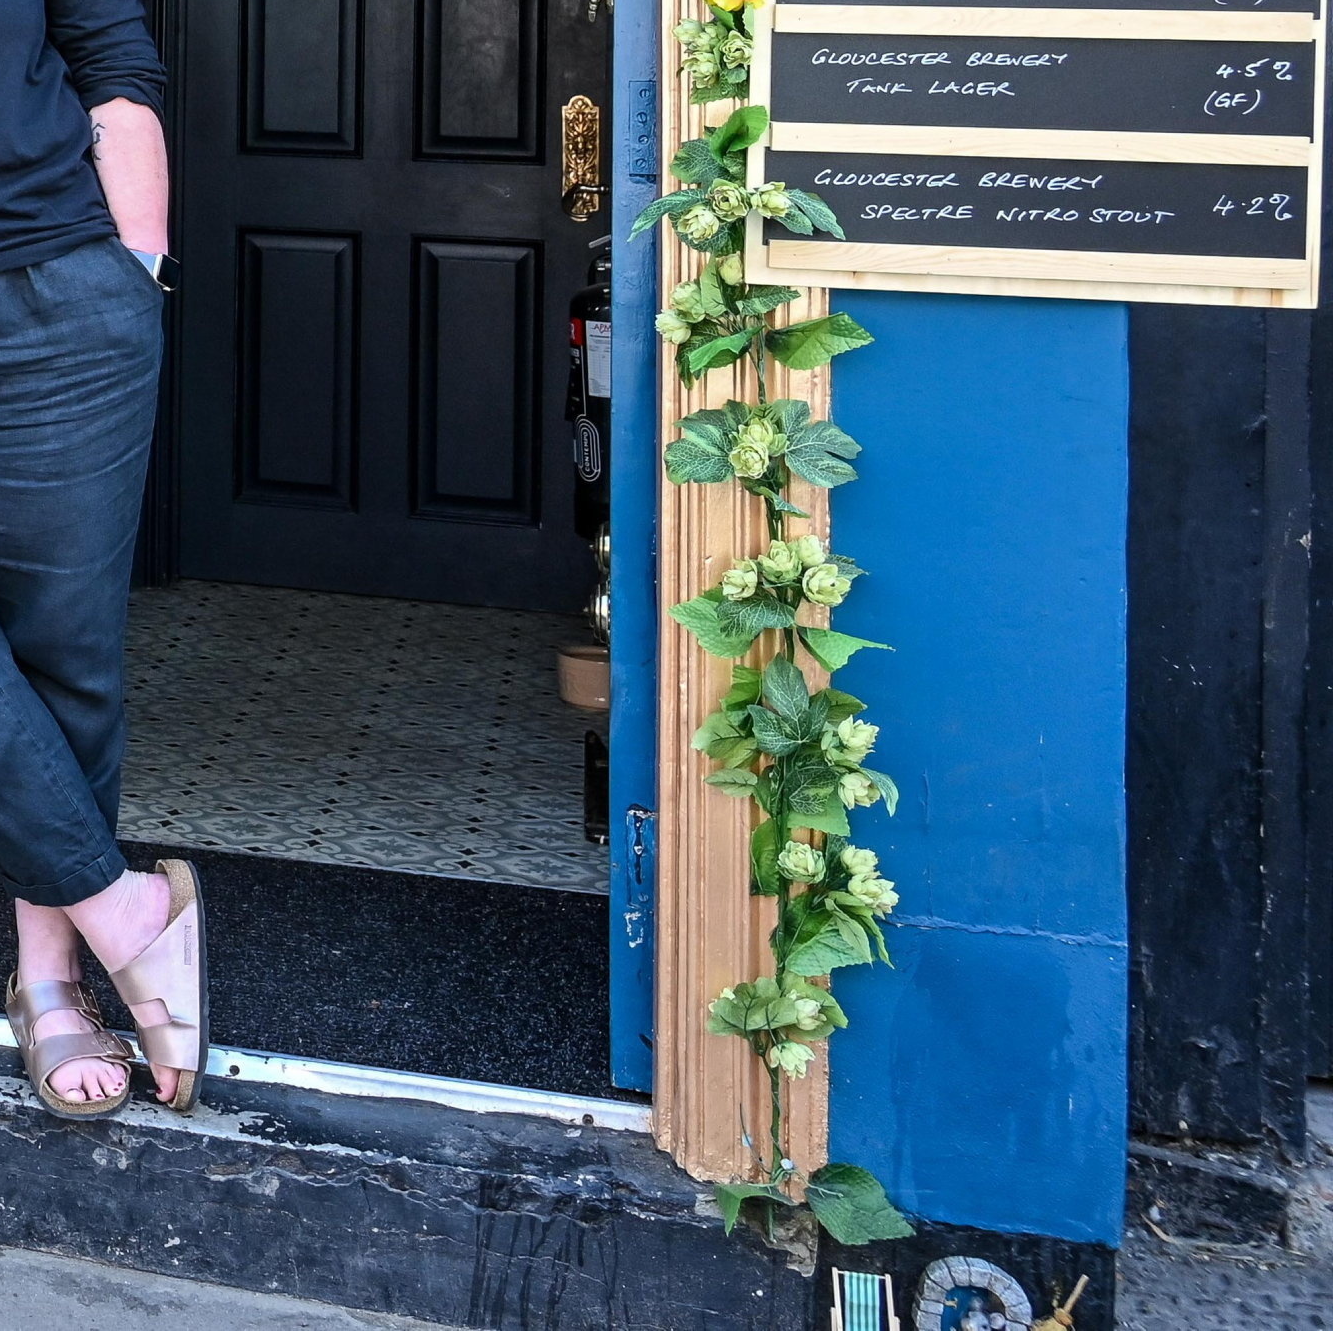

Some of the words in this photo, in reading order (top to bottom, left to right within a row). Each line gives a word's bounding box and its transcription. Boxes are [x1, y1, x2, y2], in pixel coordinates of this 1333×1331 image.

[812, 49, 951, 65] GLOUCESTER
[966, 52, 1067, 66] BREWERY
[847, 78, 912, 94] TANK
[929, 81, 1015, 96] LAGER
[814, 169, 959, 187] GLOUCESTER
[978, 172, 1102, 190] BREWERY
[861, 205, 973, 220] SPECTRE
[996, 208, 1078, 221] NITRO
[1089, 208, 1175, 223] STOUT
